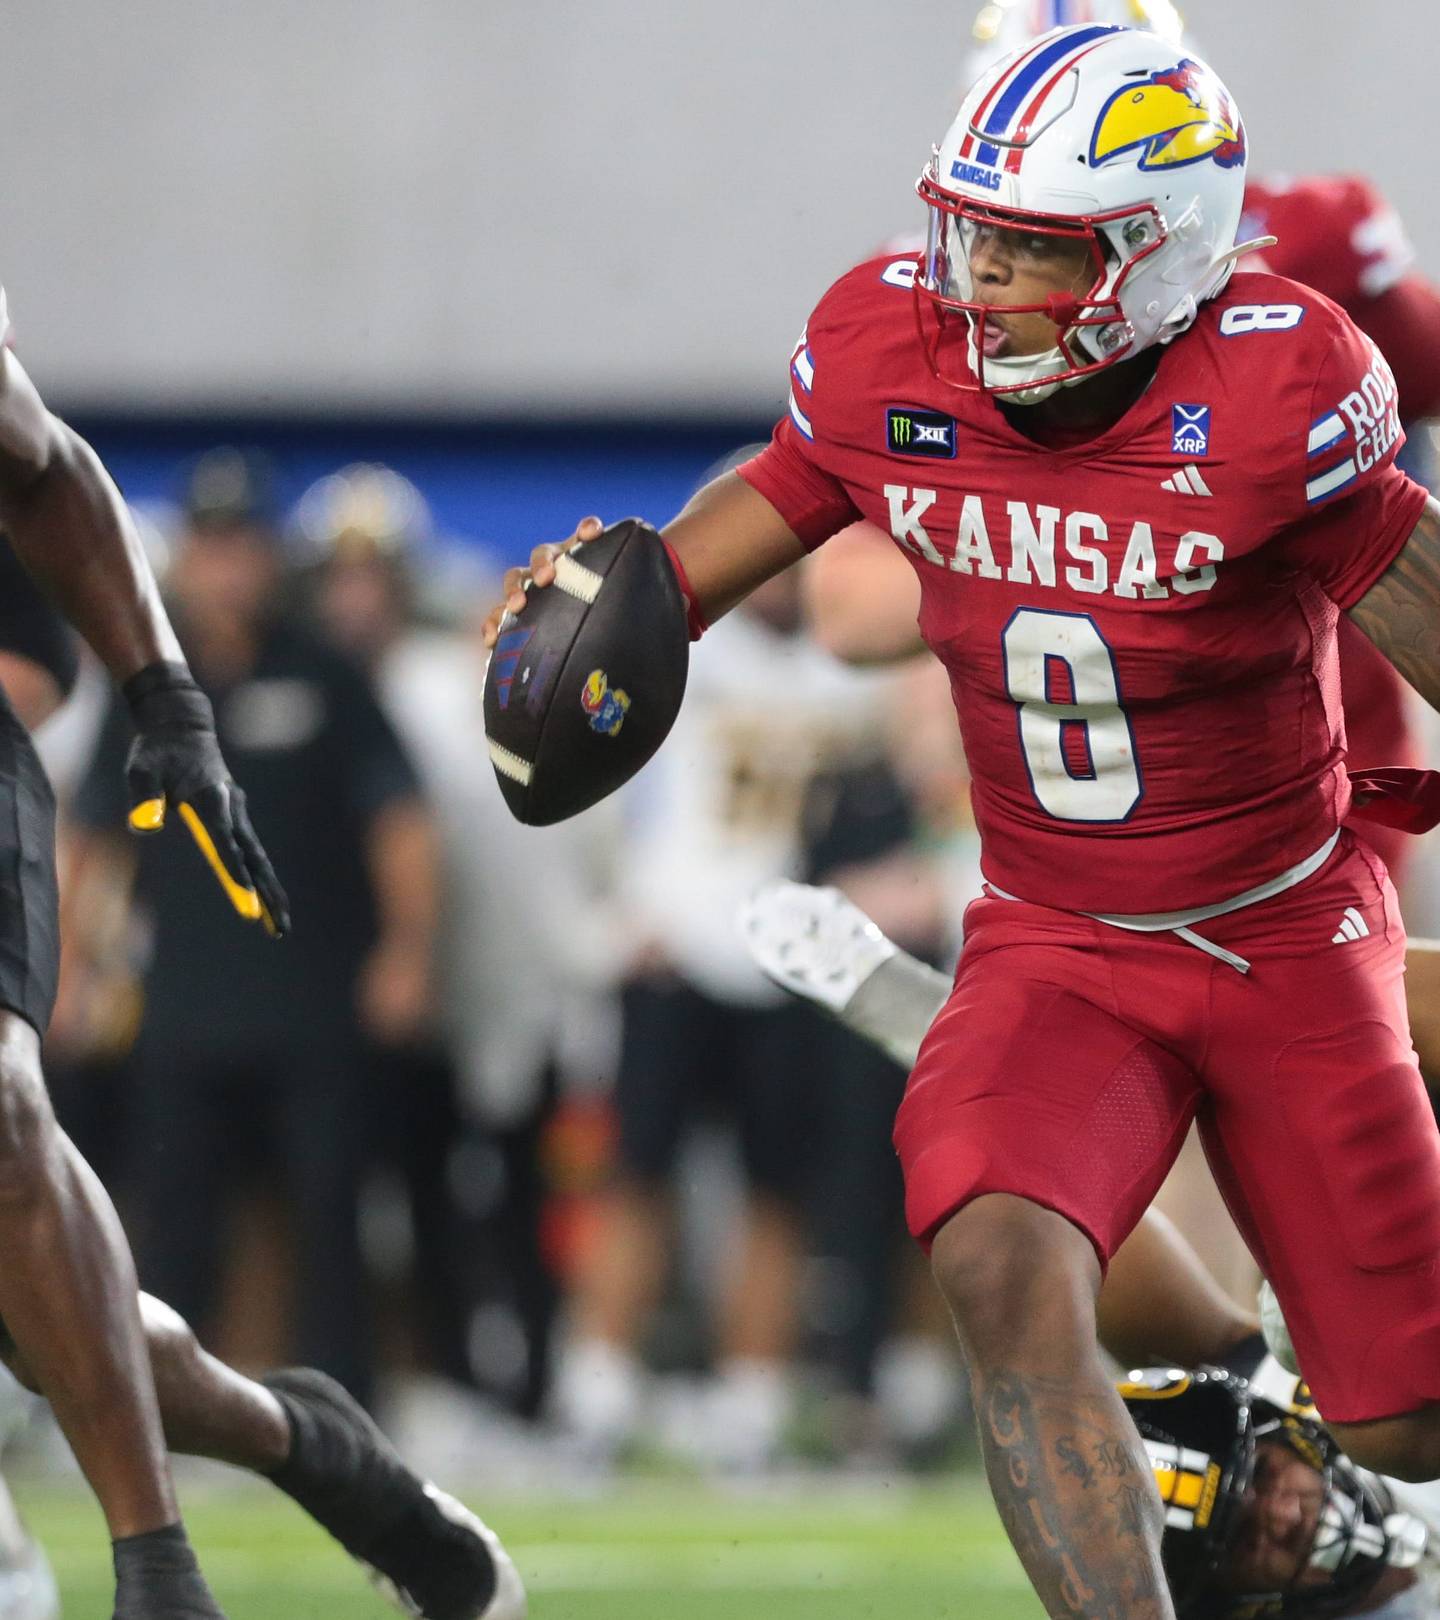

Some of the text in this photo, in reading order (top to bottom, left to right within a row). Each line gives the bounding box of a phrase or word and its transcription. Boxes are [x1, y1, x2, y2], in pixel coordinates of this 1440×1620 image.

[949, 159, 1002, 192] KANSAS
[1218, 302, 1304, 337] 8
[1173, 437, 1206, 454] XRP
[883, 483, 1225, 600] KANSAS
[1001, 604, 1145, 824] 8
